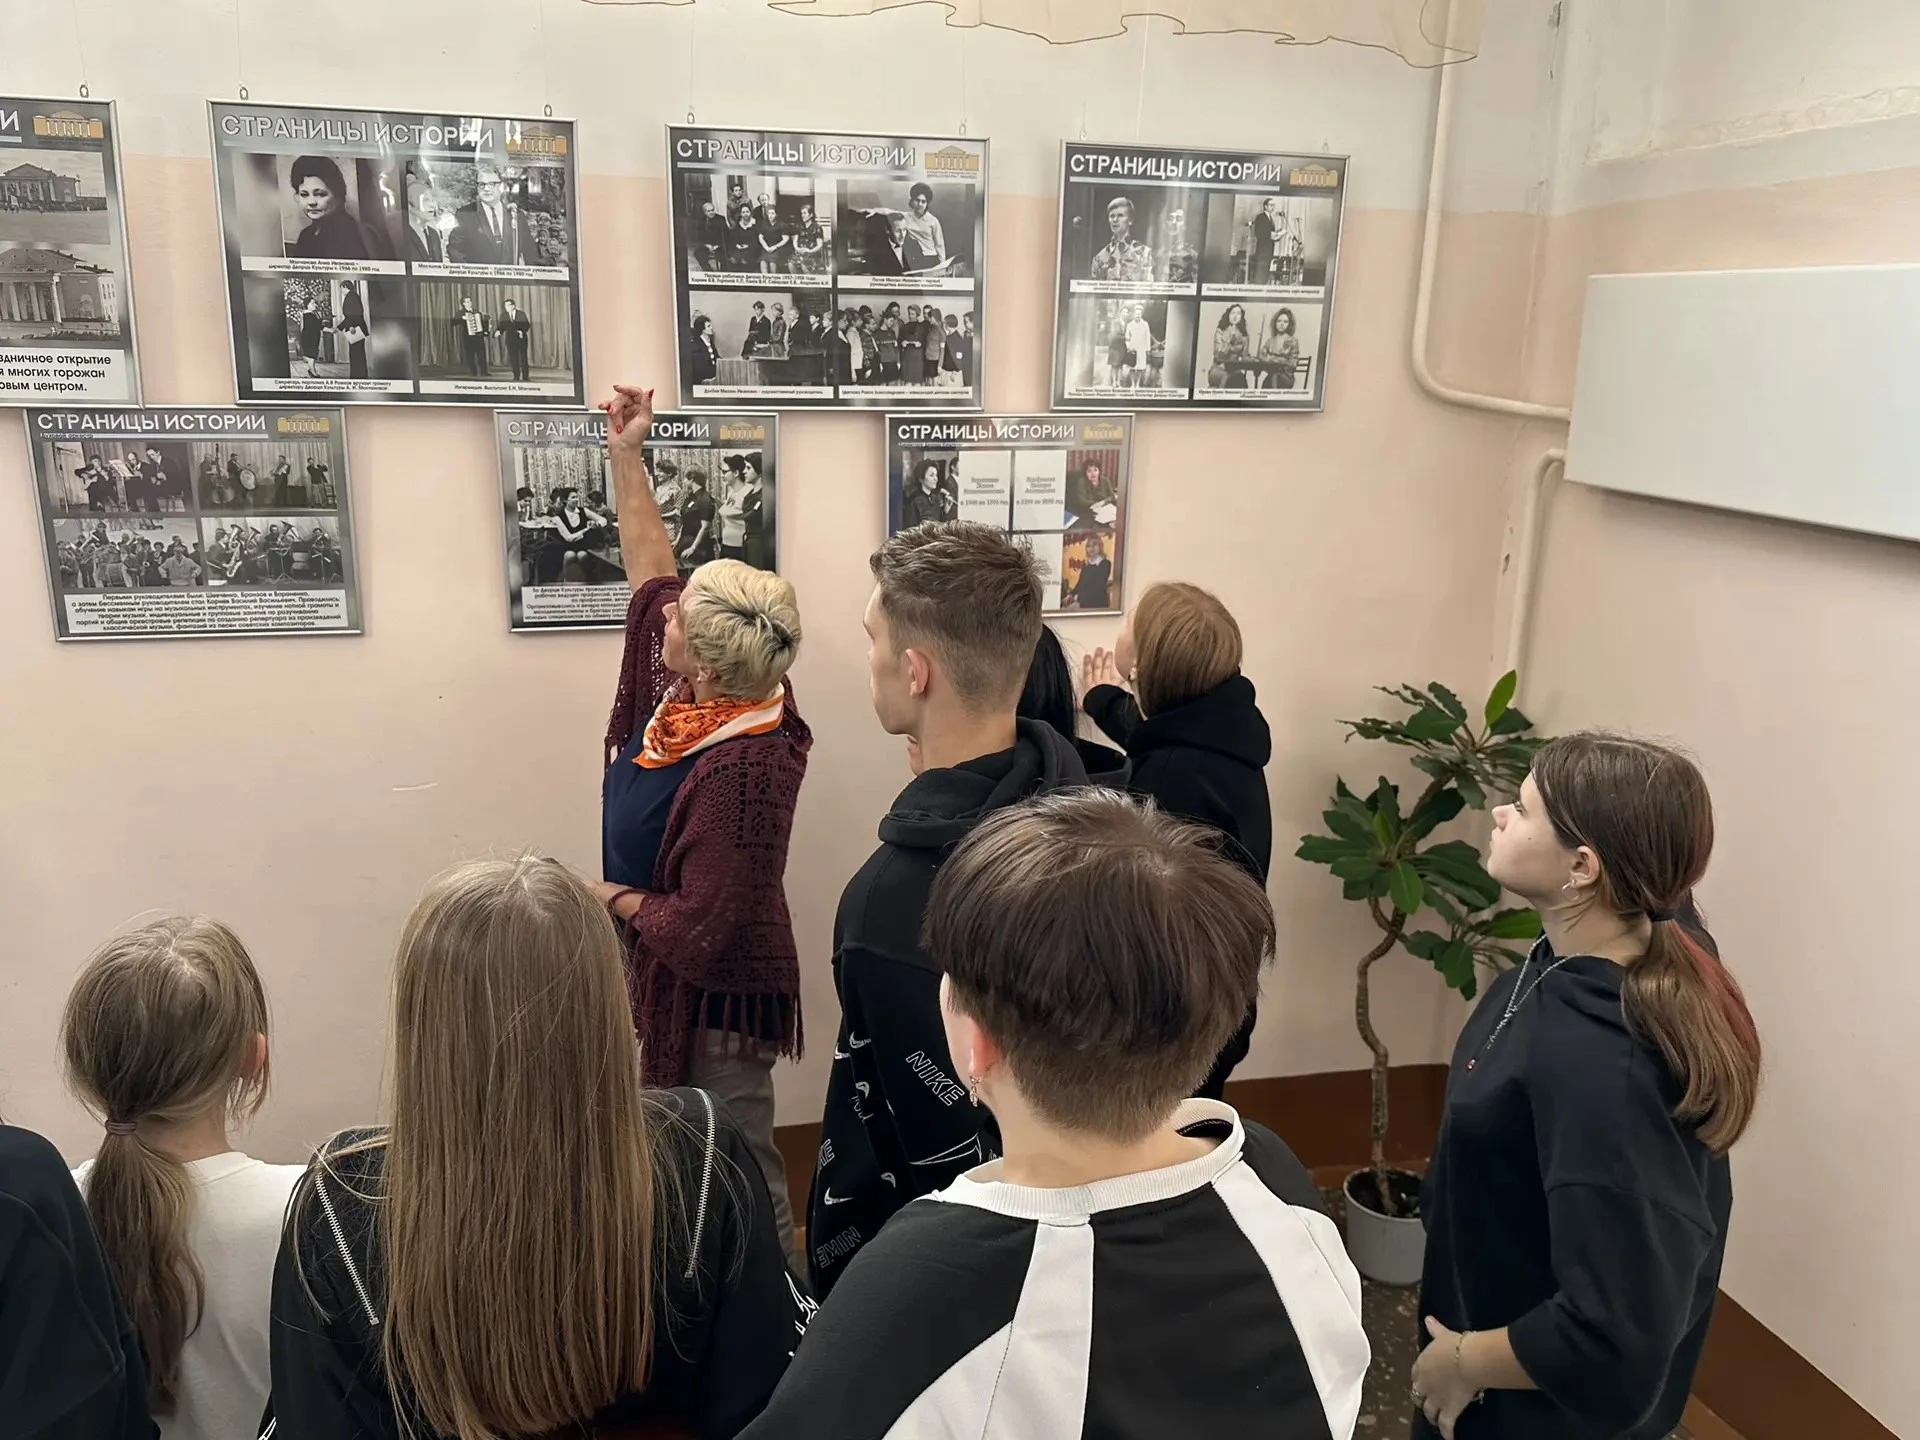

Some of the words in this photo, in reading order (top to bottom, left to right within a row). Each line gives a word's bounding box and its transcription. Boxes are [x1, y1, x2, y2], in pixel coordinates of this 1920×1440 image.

[221, 115, 367, 144] СТРАНИЦЫ
[373, 122, 494, 149] ИСТОРИИ
[676, 138, 804, 164] СТРАНИЦЫ
[809, 143, 916, 167] ИСТОРИИ
[1070, 154, 1183, 179] СТРАНИЦЫ
[1188, 159, 1282, 182] ИСТОРИИ
[57, 354, 111, 368] открытие
[8, 368, 50, 378] многих
[54, 369, 106, 380] горожан
[0, 381, 30, 390] овым
[34, 382, 87, 393] центром.
[37, 413, 160, 432] СТРАНИЦЫ
[164, 414, 267, 431] ИСТОРИИ
[651, 422, 710, 438] ТОРИИ
[898, 424, 992, 442] СТРАНИЦЫ
[997, 424, 1075, 440] ИСТОРИИ
[905, 1050, 966, 1107] NIKE
